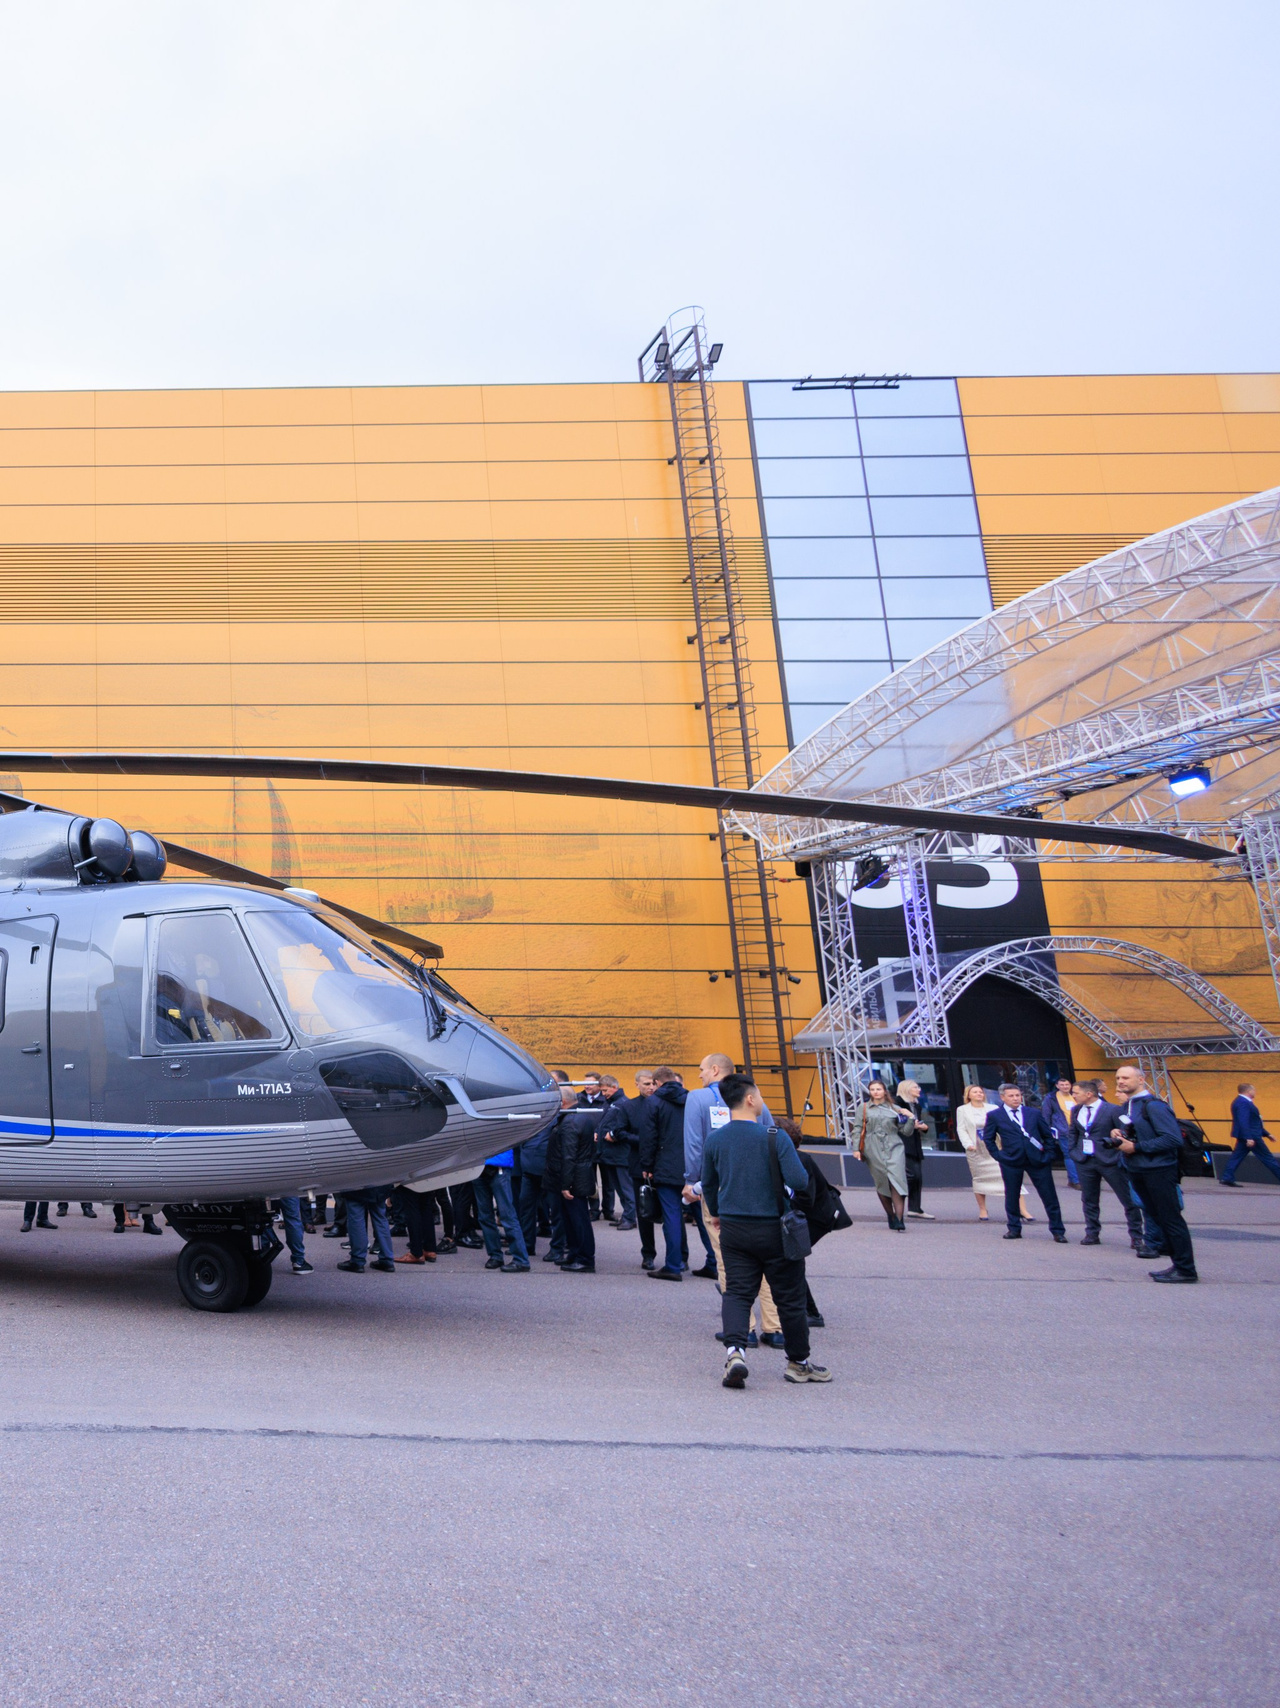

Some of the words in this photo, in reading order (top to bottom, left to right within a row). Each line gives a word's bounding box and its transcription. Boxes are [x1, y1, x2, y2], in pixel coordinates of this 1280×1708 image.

[867, 986, 880, 1029] АВИЛЬО
[237, 1083, 291, 1095] Ми-171А3
[170, 1205, 233, 1213] AURUS
